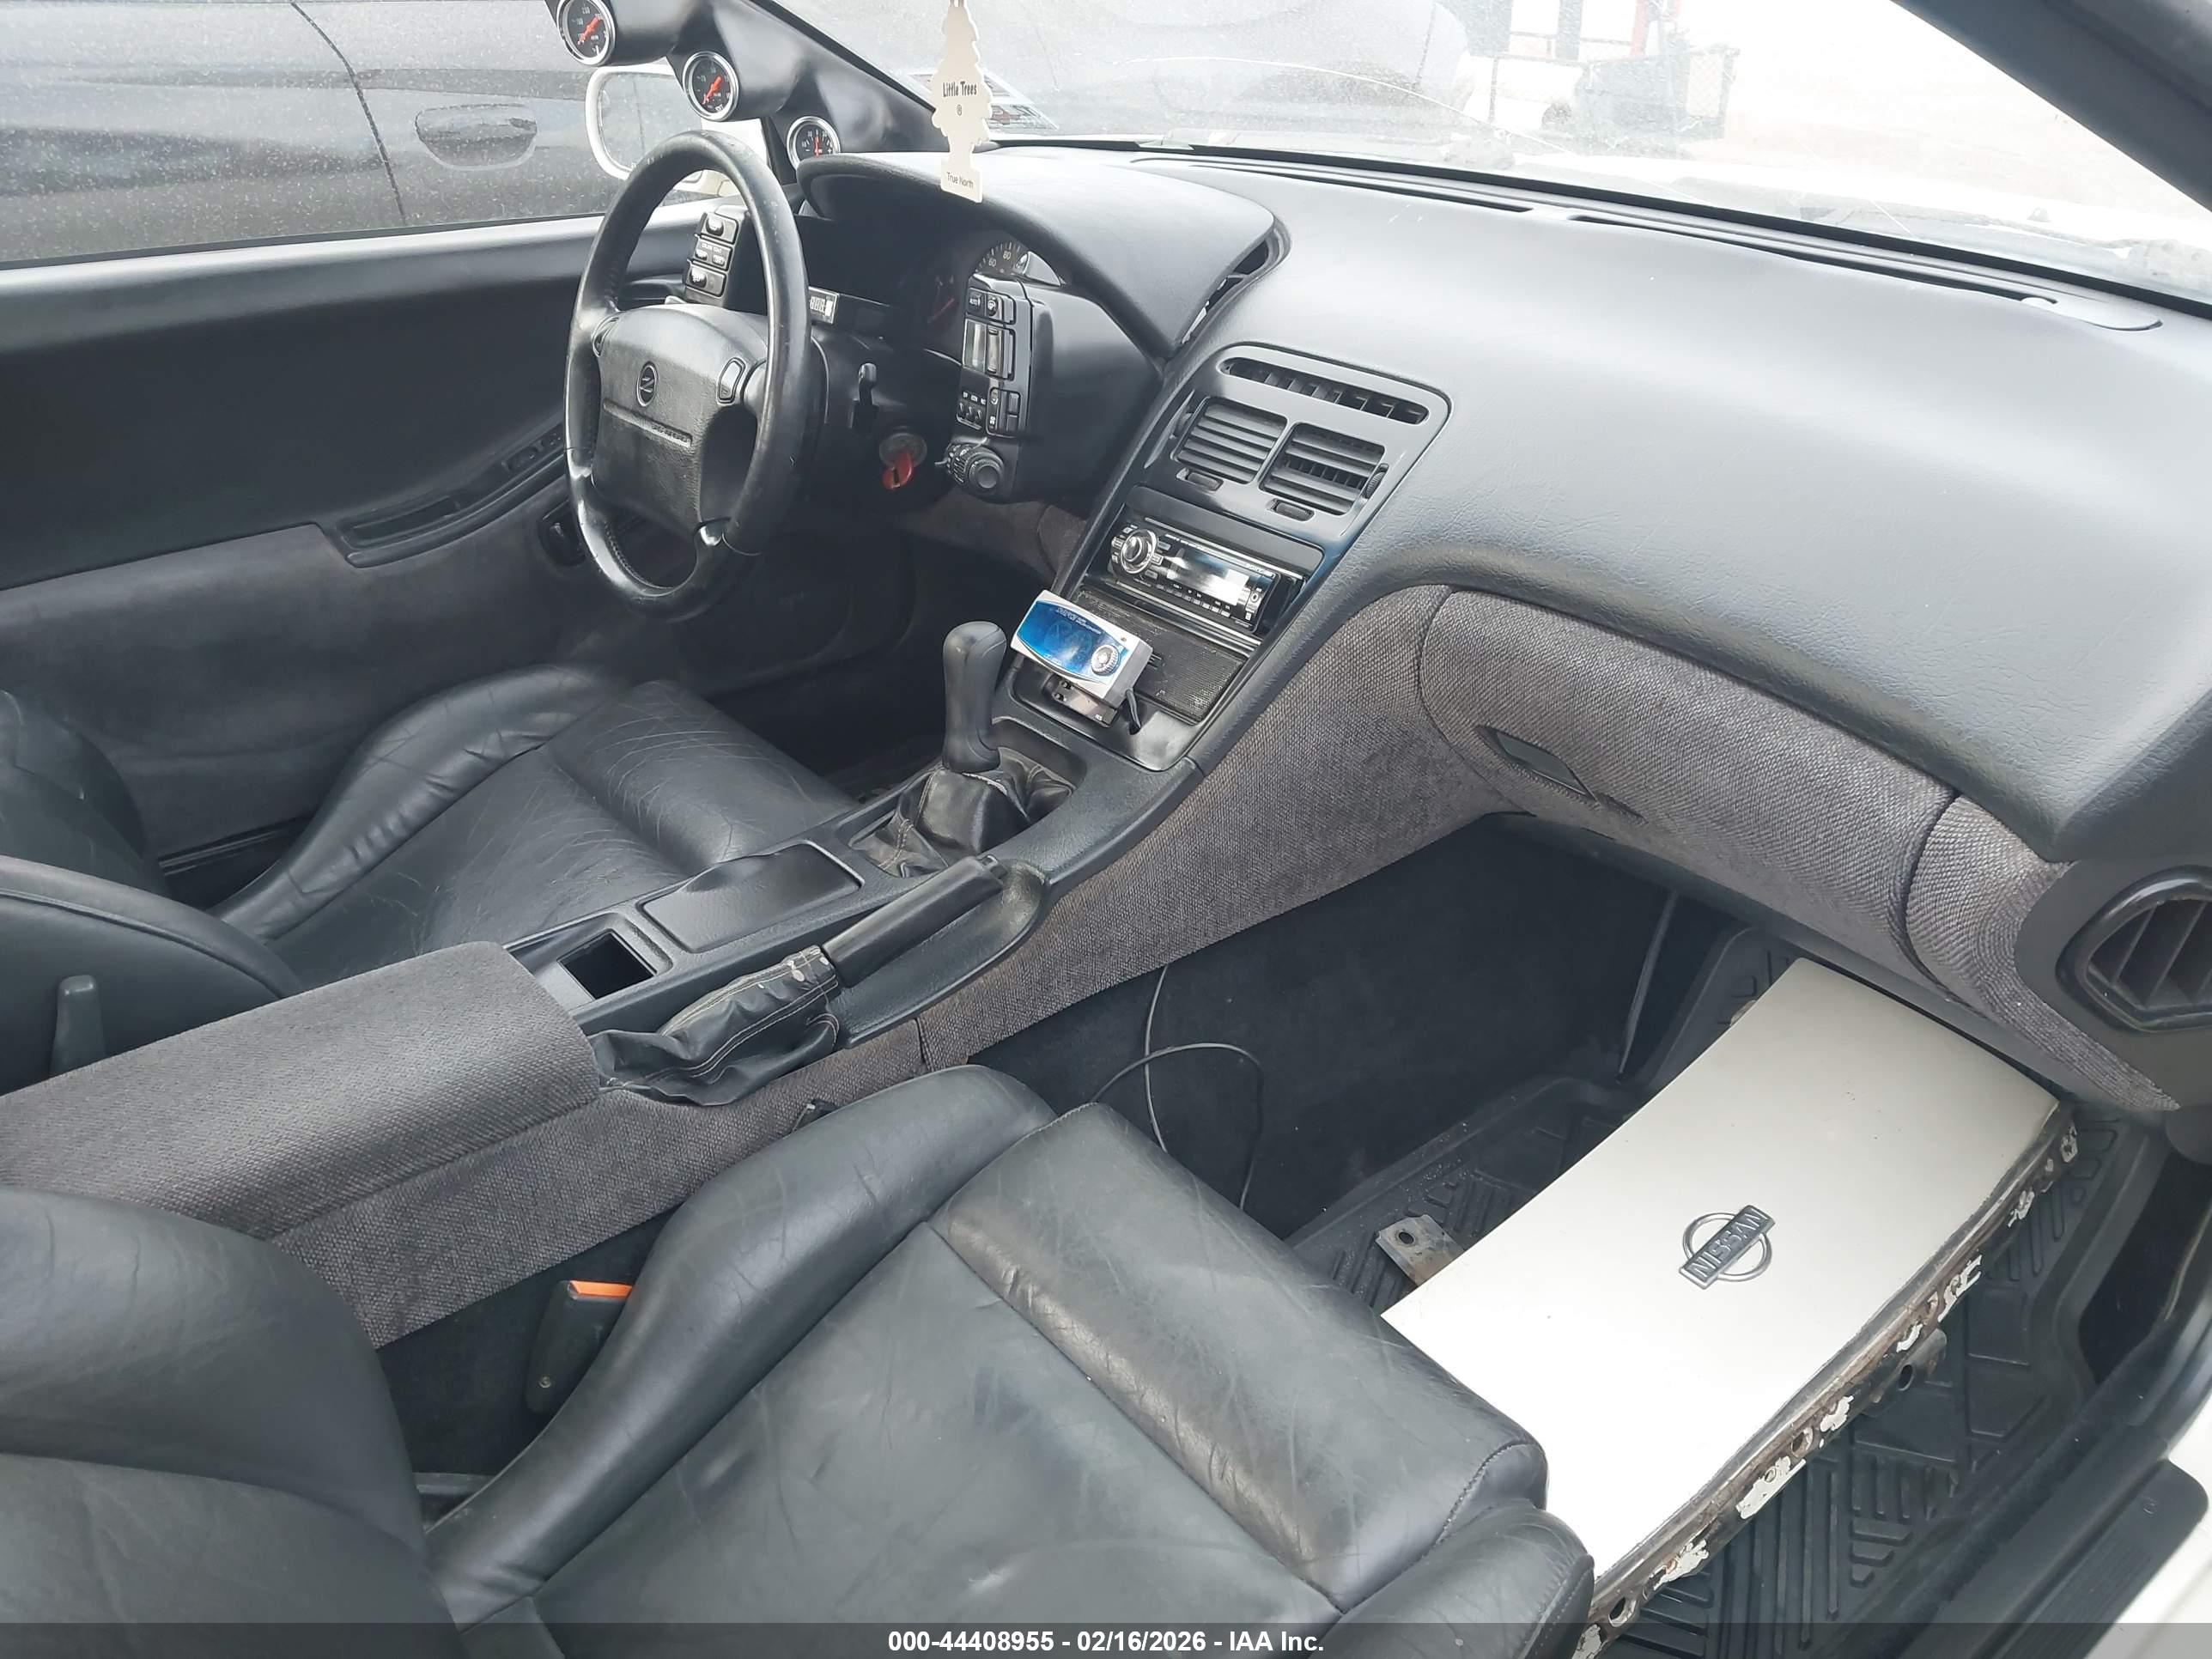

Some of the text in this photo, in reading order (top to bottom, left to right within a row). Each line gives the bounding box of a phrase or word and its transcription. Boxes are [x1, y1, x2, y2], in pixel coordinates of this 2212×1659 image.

[943, 81, 977, 97] Little Trees
[946, 171, 974, 190] True North
[988, 258, 997, 267] 60
[1003, 250, 1012, 260] 80
[1687, 1206, 1769, 1279] NISSAN
